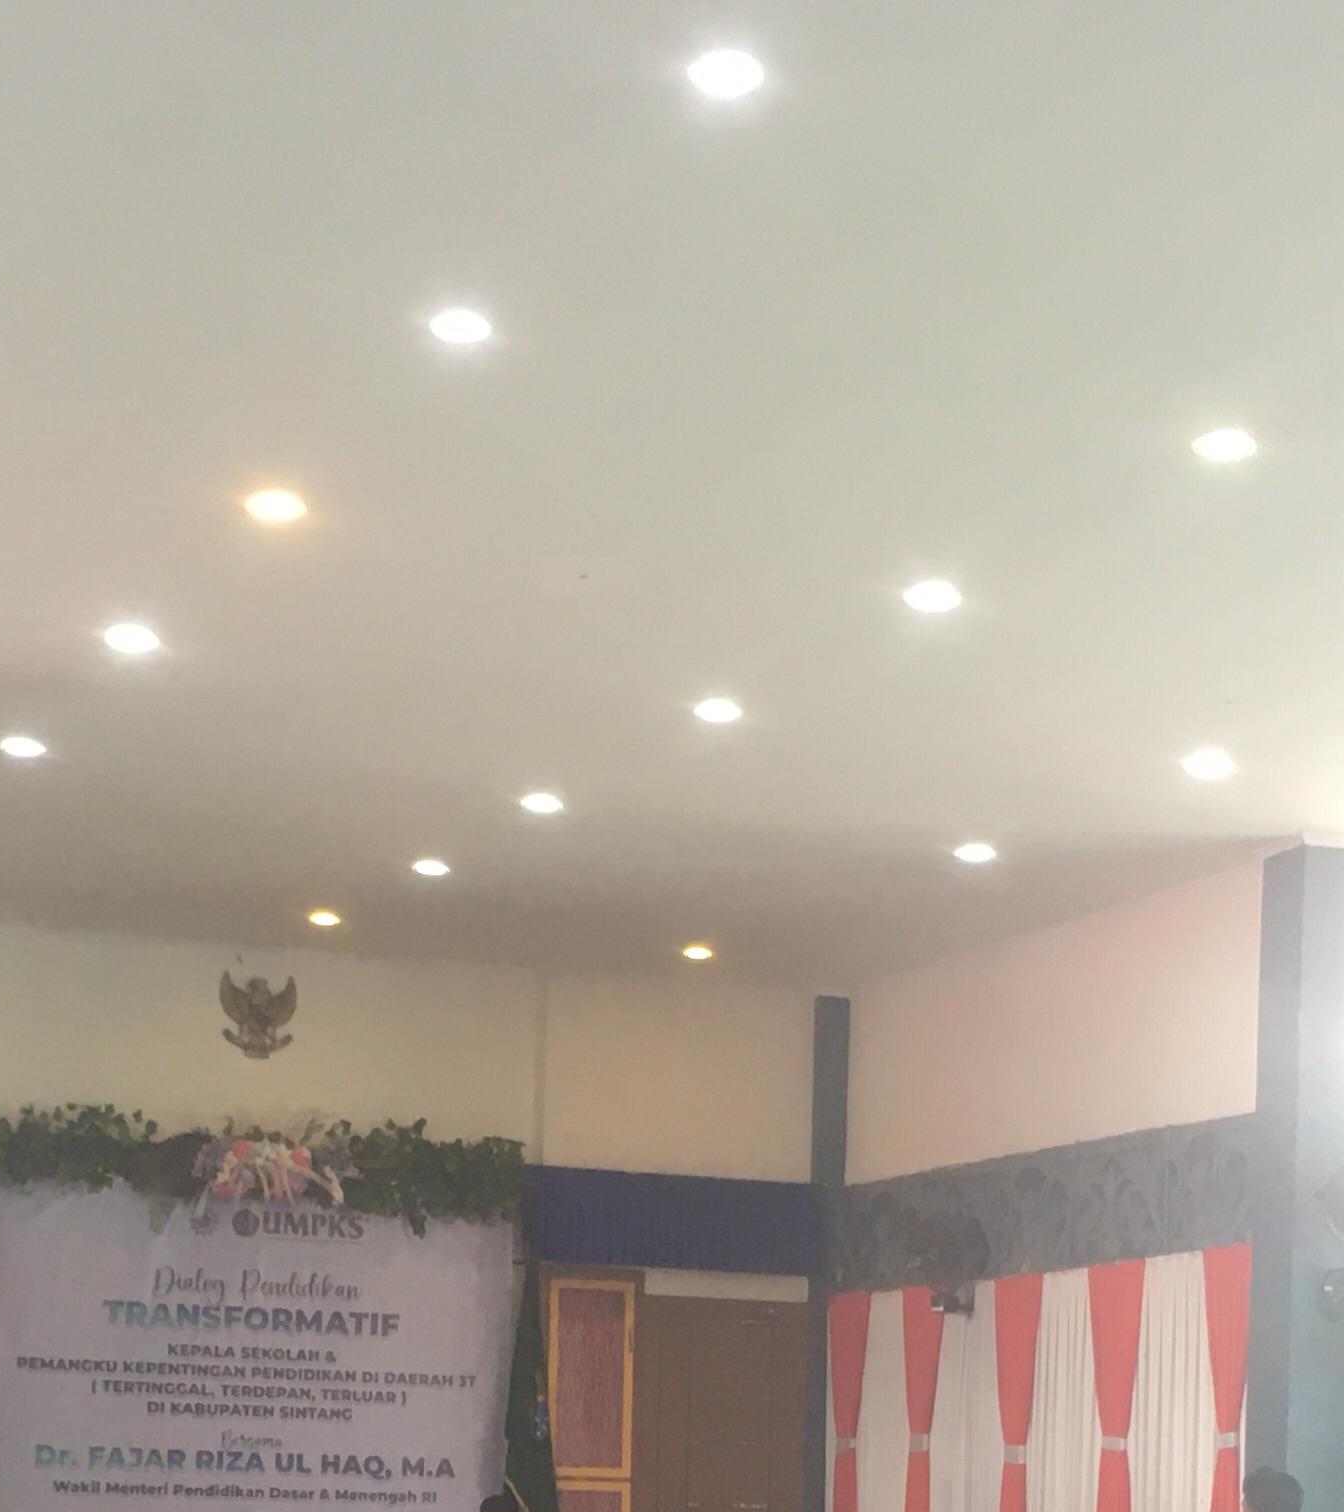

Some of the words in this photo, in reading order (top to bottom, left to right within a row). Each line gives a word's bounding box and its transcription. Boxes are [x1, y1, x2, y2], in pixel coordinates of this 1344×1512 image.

[262, 1210, 364, 1239] UMPKS
[153, 1266, 226, 1304] Dialog
[240, 1268, 361, 1300] Pendidikan
[103, 1299, 400, 1336] TRANSFORMATIF
[167, 1343, 236, 1358] KEPALA
[240, 1346, 320, 1362] SEKOLAH
[16, 1356, 118, 1373] PEMANGKU
[123, 1361, 246, 1378] KEPENTINGAN
[251, 1366, 357, 1383] PENDIDIKAN
[362, 1371, 379, 1384] DI
[384, 1372, 454, 1387] DAERAH
[321, 1388, 397, 1403] TERLUAR
[147, 1401, 165, 1414] DI
[170, 1402, 275, 1417] KABUPATEN
[279, 1406, 353, 1421] SINTANG
[35, 1444, 77, 1468] Dr.
[88, 1446, 186, 1470] FAJAR
[195, 1450, 266, 1472] RIZA
[275, 1453, 312, 1474] UL
[320, 1454, 393, 1479] HAQ,
[401, 1456, 455, 1479] M.A
[53, 1480, 101, 1494] Wakil
[106, 1482, 169, 1496] Menteri
[173, 1484, 265, 1498] Pendidikan
[269, 1487, 315, 1500] Dasar
[335, 1489, 417, 1505] Menengah
[422, 1491, 438, 1503] RI
